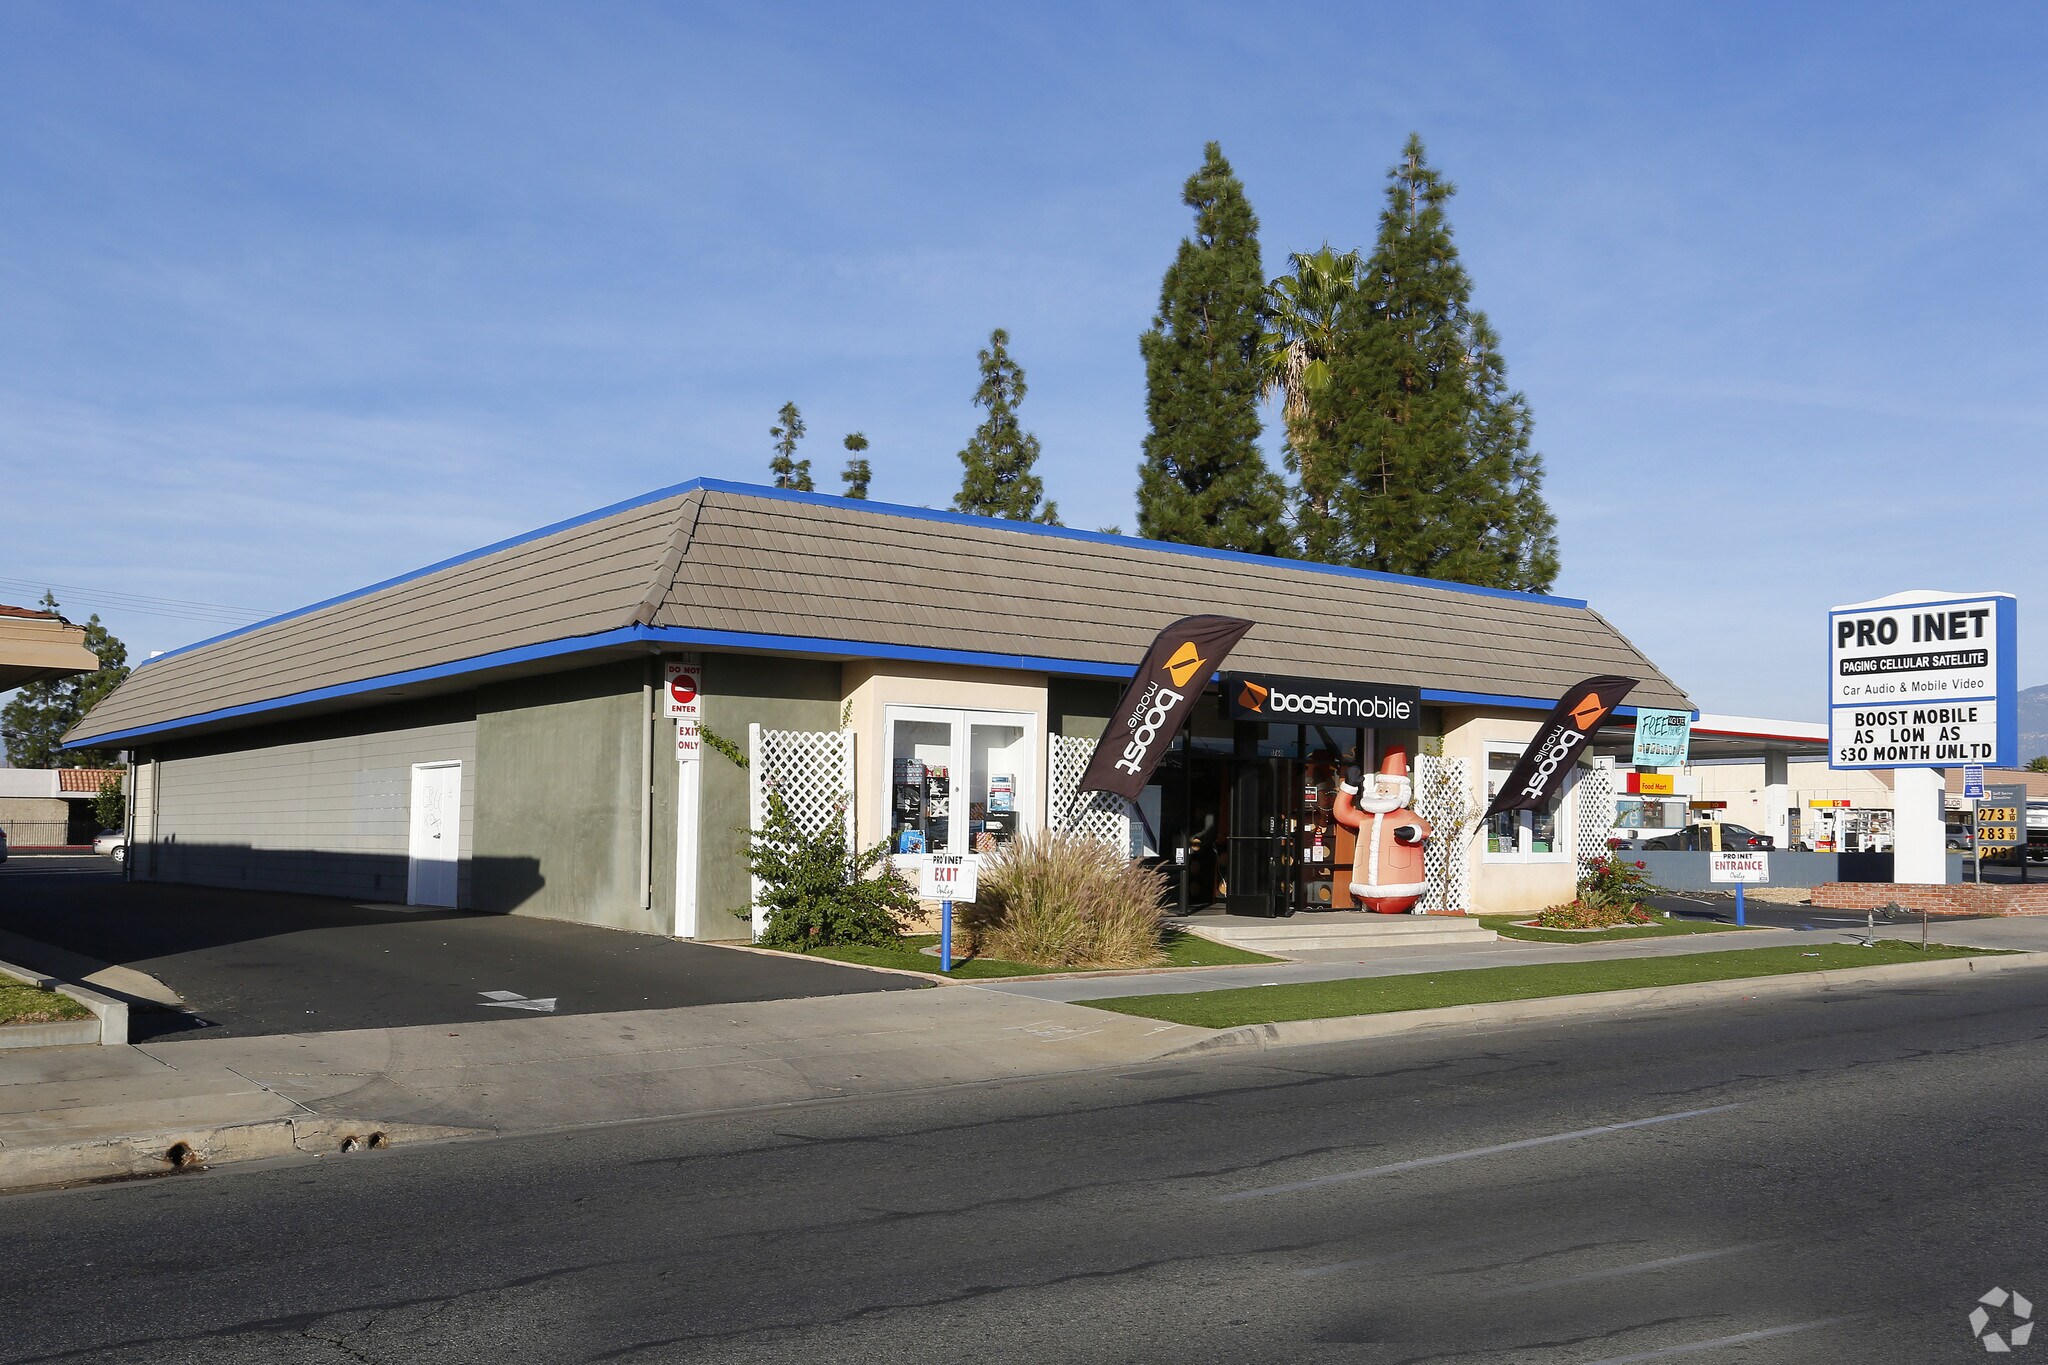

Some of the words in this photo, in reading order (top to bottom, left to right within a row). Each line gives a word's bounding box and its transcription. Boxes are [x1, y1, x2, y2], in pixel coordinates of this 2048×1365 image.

[1838, 616, 1899, 648] PRO
[1912, 608, 1990, 642] INET
[668, 665, 681, 673] DO
[684, 666, 701, 675] NOT
[1843, 660, 1877, 673] PAGING
[1880, 656, 1930, 670] CELLULAR
[1932, 652, 1985, 666] SATELLITE
[1843, 685, 1861, 696] Car
[1864, 683, 1896, 695] Audio
[1899, 682, 1907, 693] &
[1911, 680, 1948, 692] Mobile
[1952, 678, 1985, 690] Video
[671, 705, 696, 713] ENTER
[1127, 680, 1159, 729] mobile
[1855, 710, 1908, 727] BOOST
[1913, 707, 1978, 725] MOBILE
[679, 727, 700, 737] EXIT
[1114, 688, 1185, 776] boost
[1642, 715, 1668, 736] FREE
[1854, 729, 1875, 744] AS
[1890, 728, 1925, 743] LOW
[1939, 726, 1961, 742] AS
[678, 741, 699, 750] ONLY
[1533, 724, 1564, 763] mobile
[1840, 747, 1868, 761] $30
[1873, 745, 1930, 761] MONTH
[1935, 743, 1992, 759] UNLTD
[1521, 730, 1585, 799] boost
[1642, 782, 1654, 790] Food
[1655, 783, 1667, 791] Mart
[1979, 809, 2005, 820] 273
[1977, 828, 2005, 840] 283
[933, 855, 943, 864] PRO
[944, 855, 963, 865] INET
[1981, 847, 2007, 859] 293
[1715, 861, 1763, 870] ENTRANCE
[934, 867, 959, 881] EXIT
